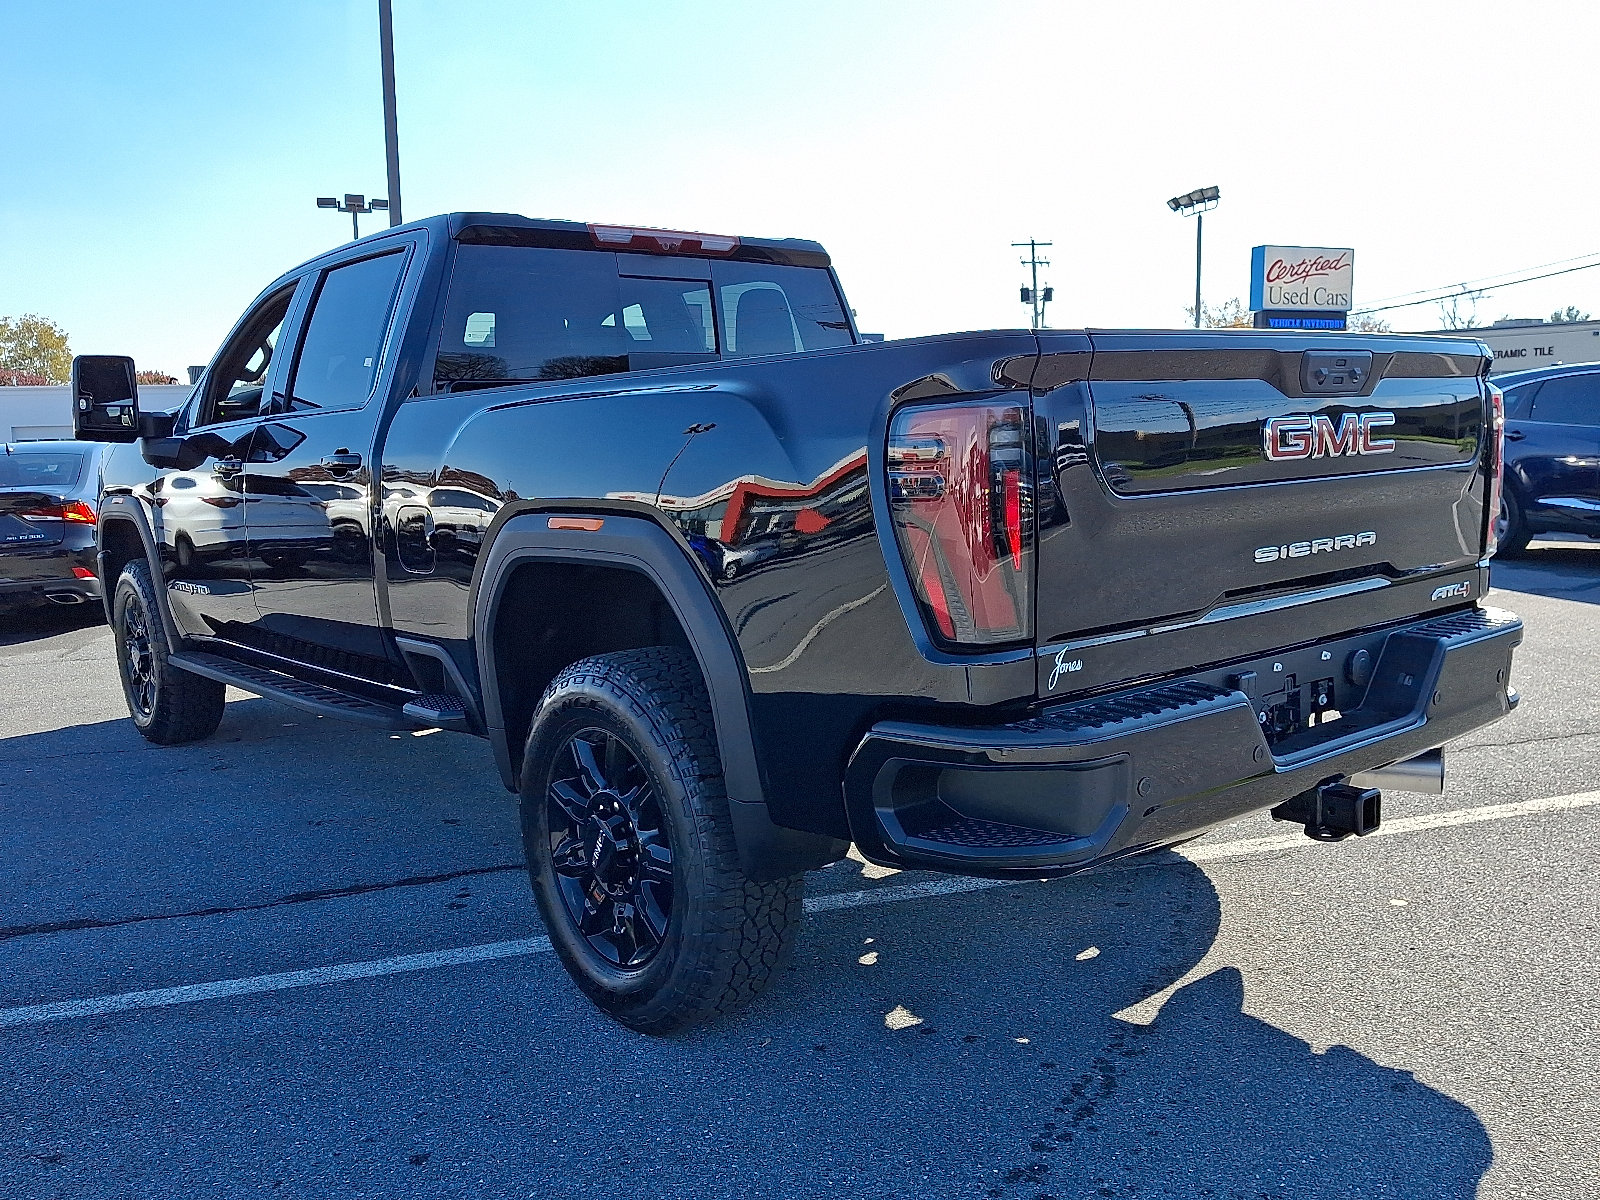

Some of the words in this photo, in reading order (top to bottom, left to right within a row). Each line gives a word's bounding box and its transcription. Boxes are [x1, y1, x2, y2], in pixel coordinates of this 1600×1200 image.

[1266, 252, 1351, 284] Certified
[1268, 285, 1309, 305] Used
[1313, 286, 1348, 306] Cars
[1493, 348, 1527, 360] ERAMIC
[1533, 346, 1554, 357] TILE
[1262, 411, 1396, 461] GMC
[1253, 531, 1377, 563] SIERRA
[1431, 580, 1471, 601] AT4
[1048, 645, 1083, 691] Jones
